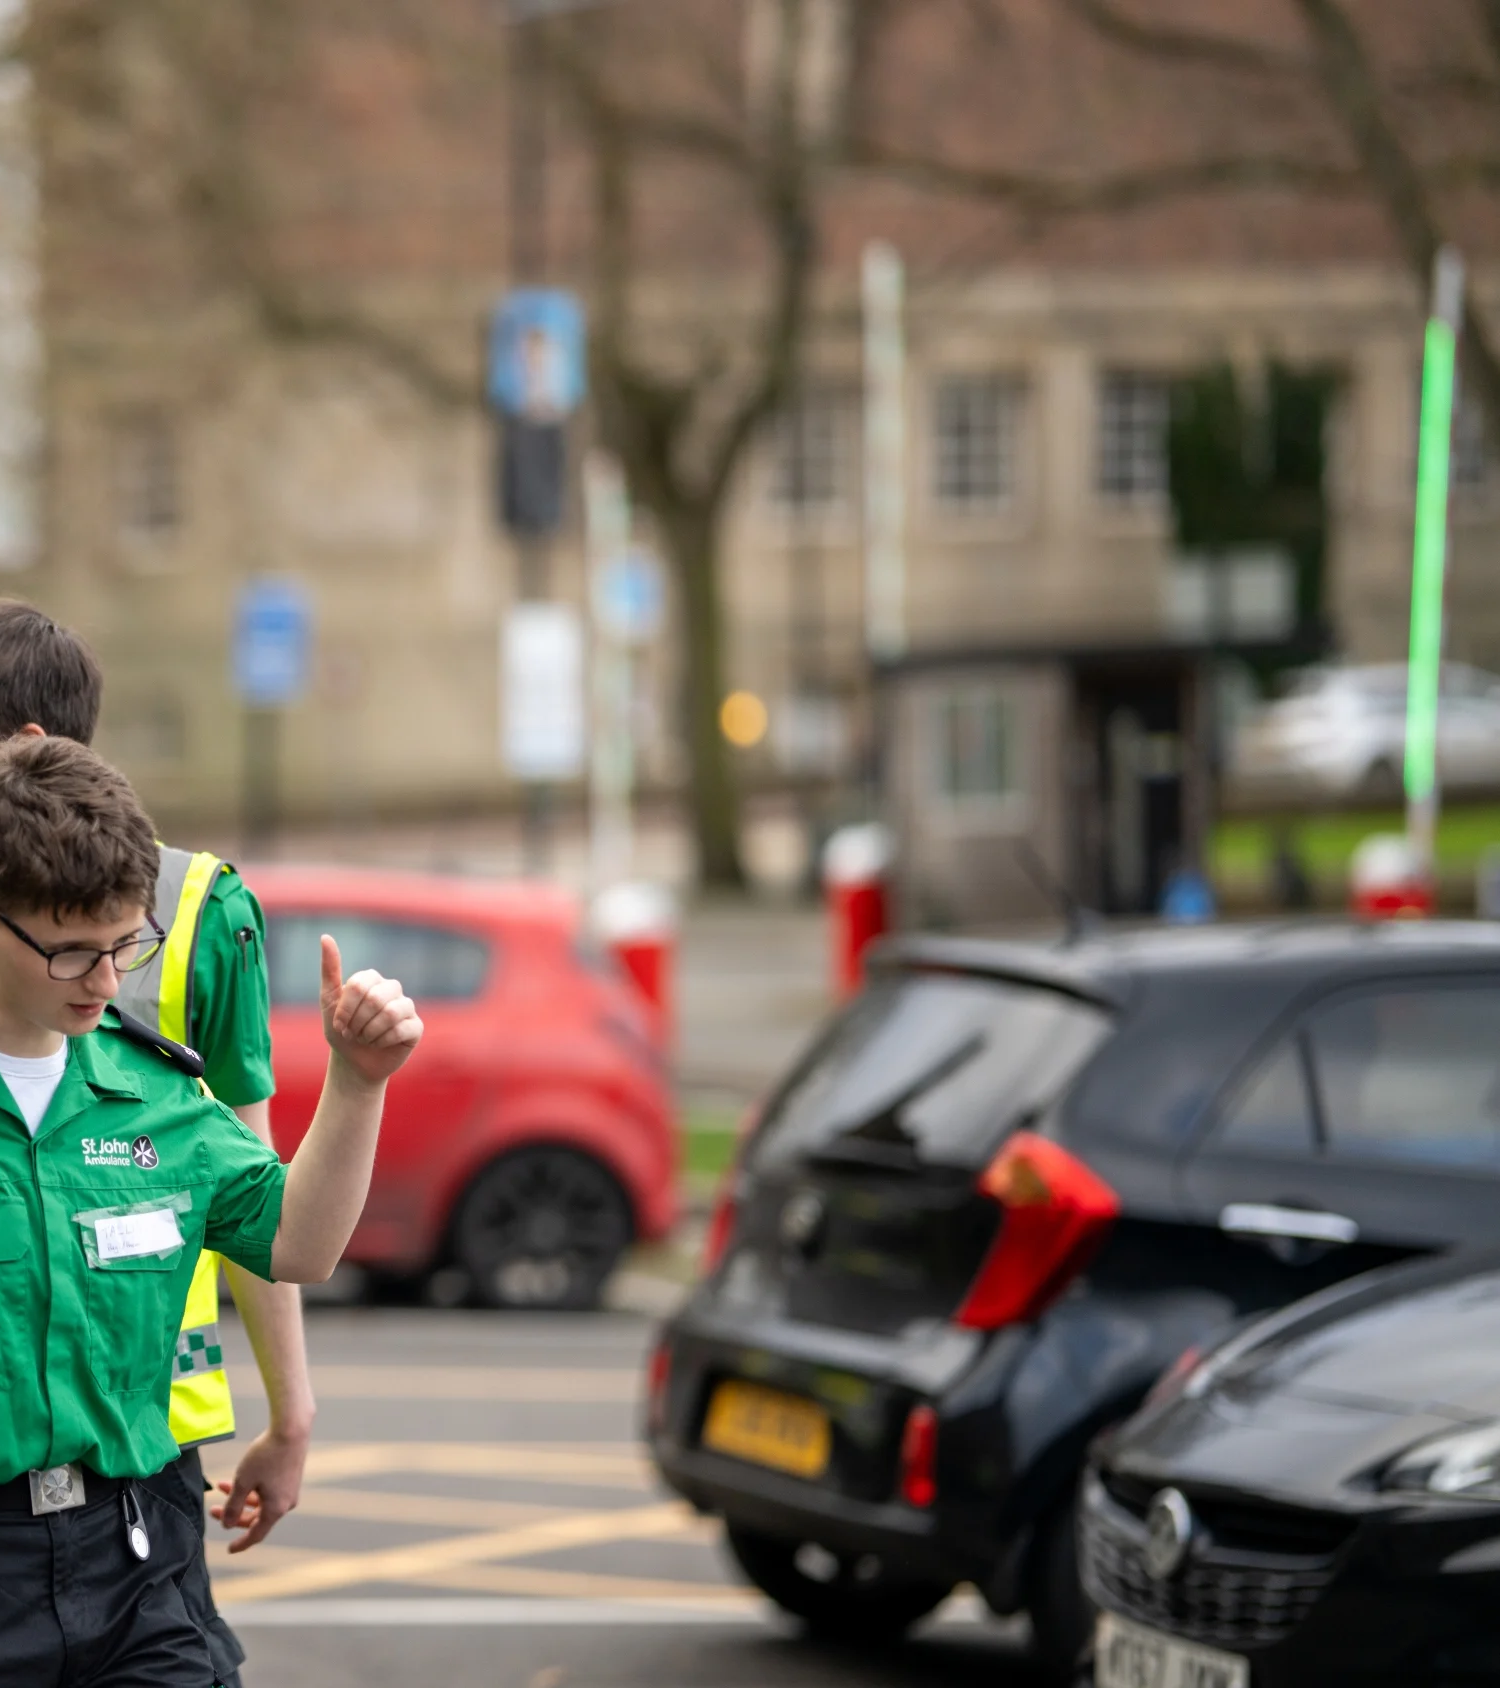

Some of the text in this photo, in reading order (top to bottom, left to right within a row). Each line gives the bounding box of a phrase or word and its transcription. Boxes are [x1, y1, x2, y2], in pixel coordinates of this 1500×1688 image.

[81, 1138, 130, 1155] St John
[84, 1155, 131, 1167] Ambulance
